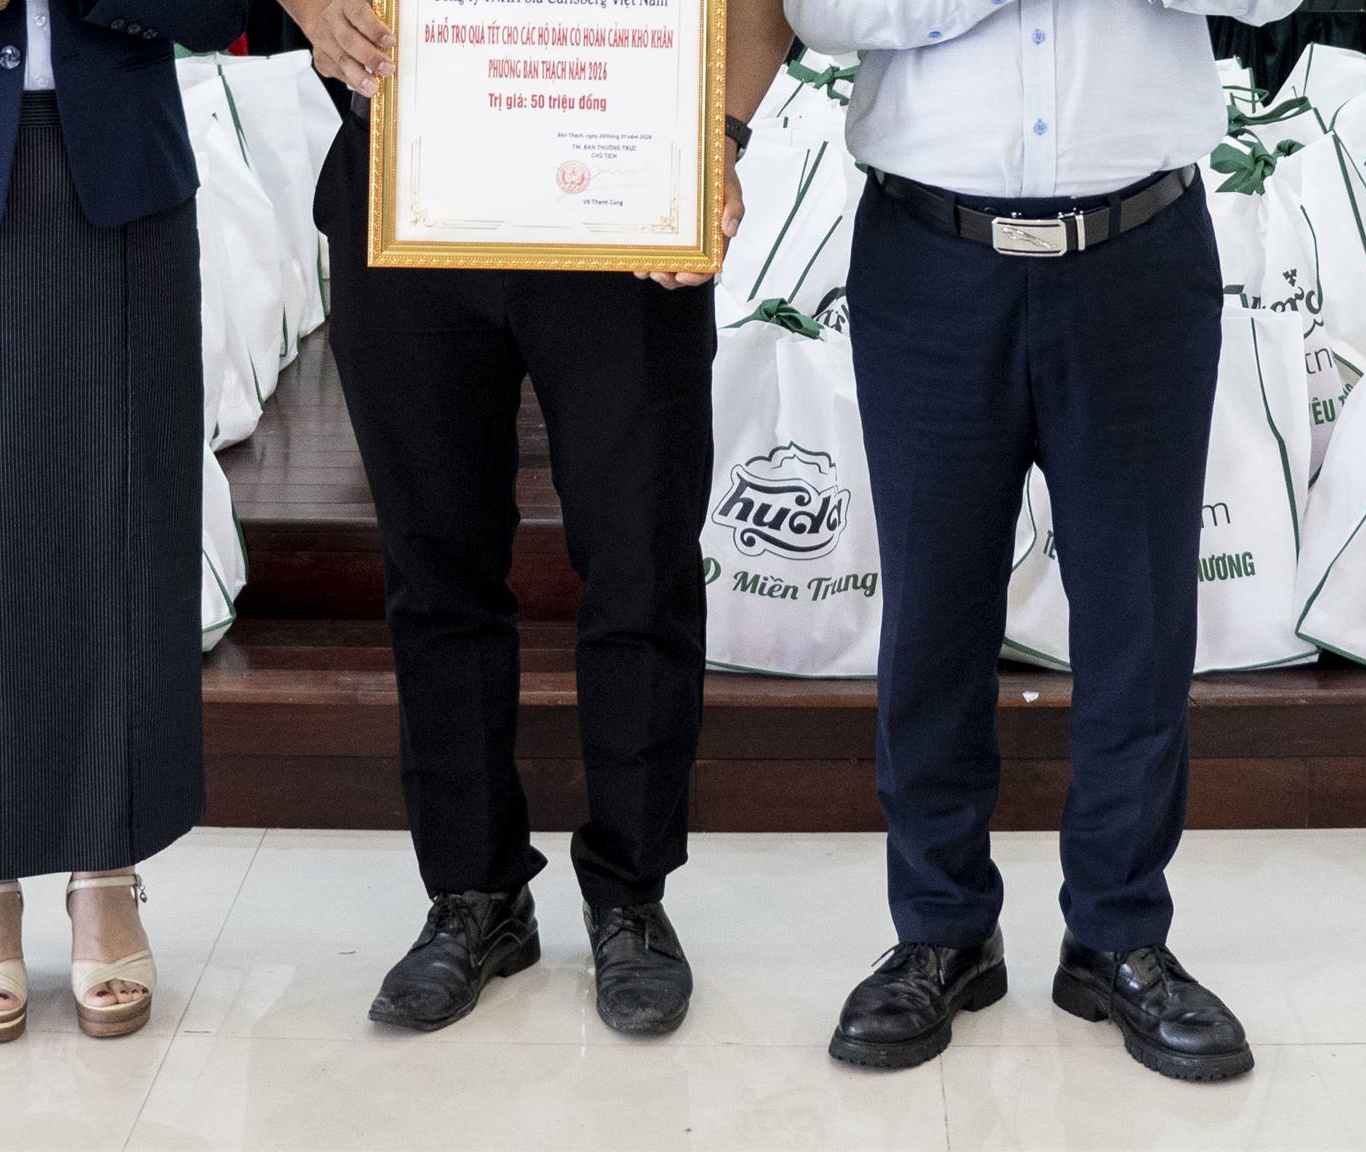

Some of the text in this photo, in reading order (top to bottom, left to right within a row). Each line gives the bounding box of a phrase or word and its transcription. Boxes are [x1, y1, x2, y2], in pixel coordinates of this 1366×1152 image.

[487, 18, 500, 44] TẾT
[501, 25, 519, 45] CHO
[588, 61, 608, 81] 2026
[488, 93, 502, 111] Trị
[506, 93, 527, 110] giá:
[530, 94, 545, 109] 50
[548, 94, 575, 113] triệu
[1308, 396, 1336, 425] ÊU
[1198, 551, 1256, 583] ƯƠNG
[732, 570, 879, 601] Miền Trung
